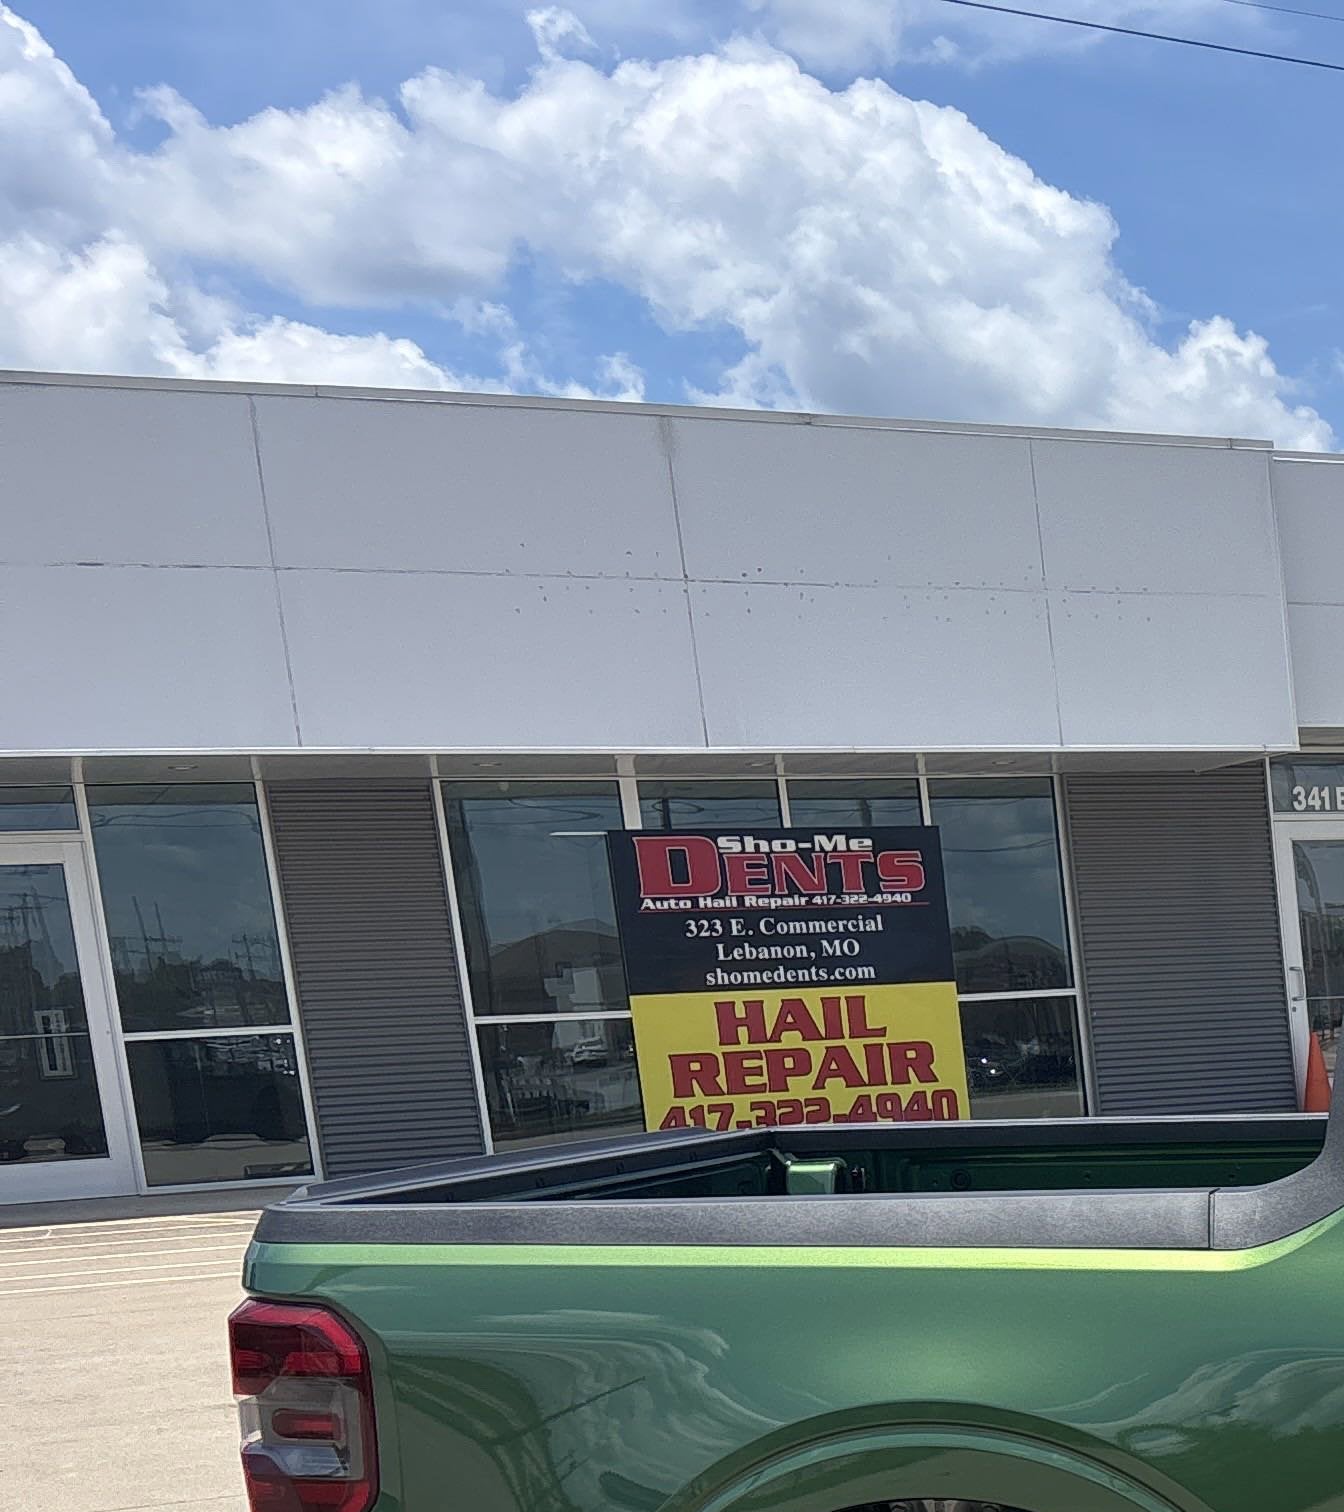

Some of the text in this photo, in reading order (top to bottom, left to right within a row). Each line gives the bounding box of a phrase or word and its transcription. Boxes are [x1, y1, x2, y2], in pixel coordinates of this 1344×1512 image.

[1292, 785, 1331, 811] 341
[717, 834, 873, 853] Sho-Me
[632, 835, 925, 898] DENTS
[640, 892, 912, 911] Auto Hail Repair 417-322-4940
[685, 914, 884, 938] 323 E. Commercial
[716, 938, 860, 961] Lebanon, MO
[705, 965, 876, 986] shomedents.com
[714, 996, 887, 1046] HAIL
[668, 1041, 939, 1098] REPAIR
